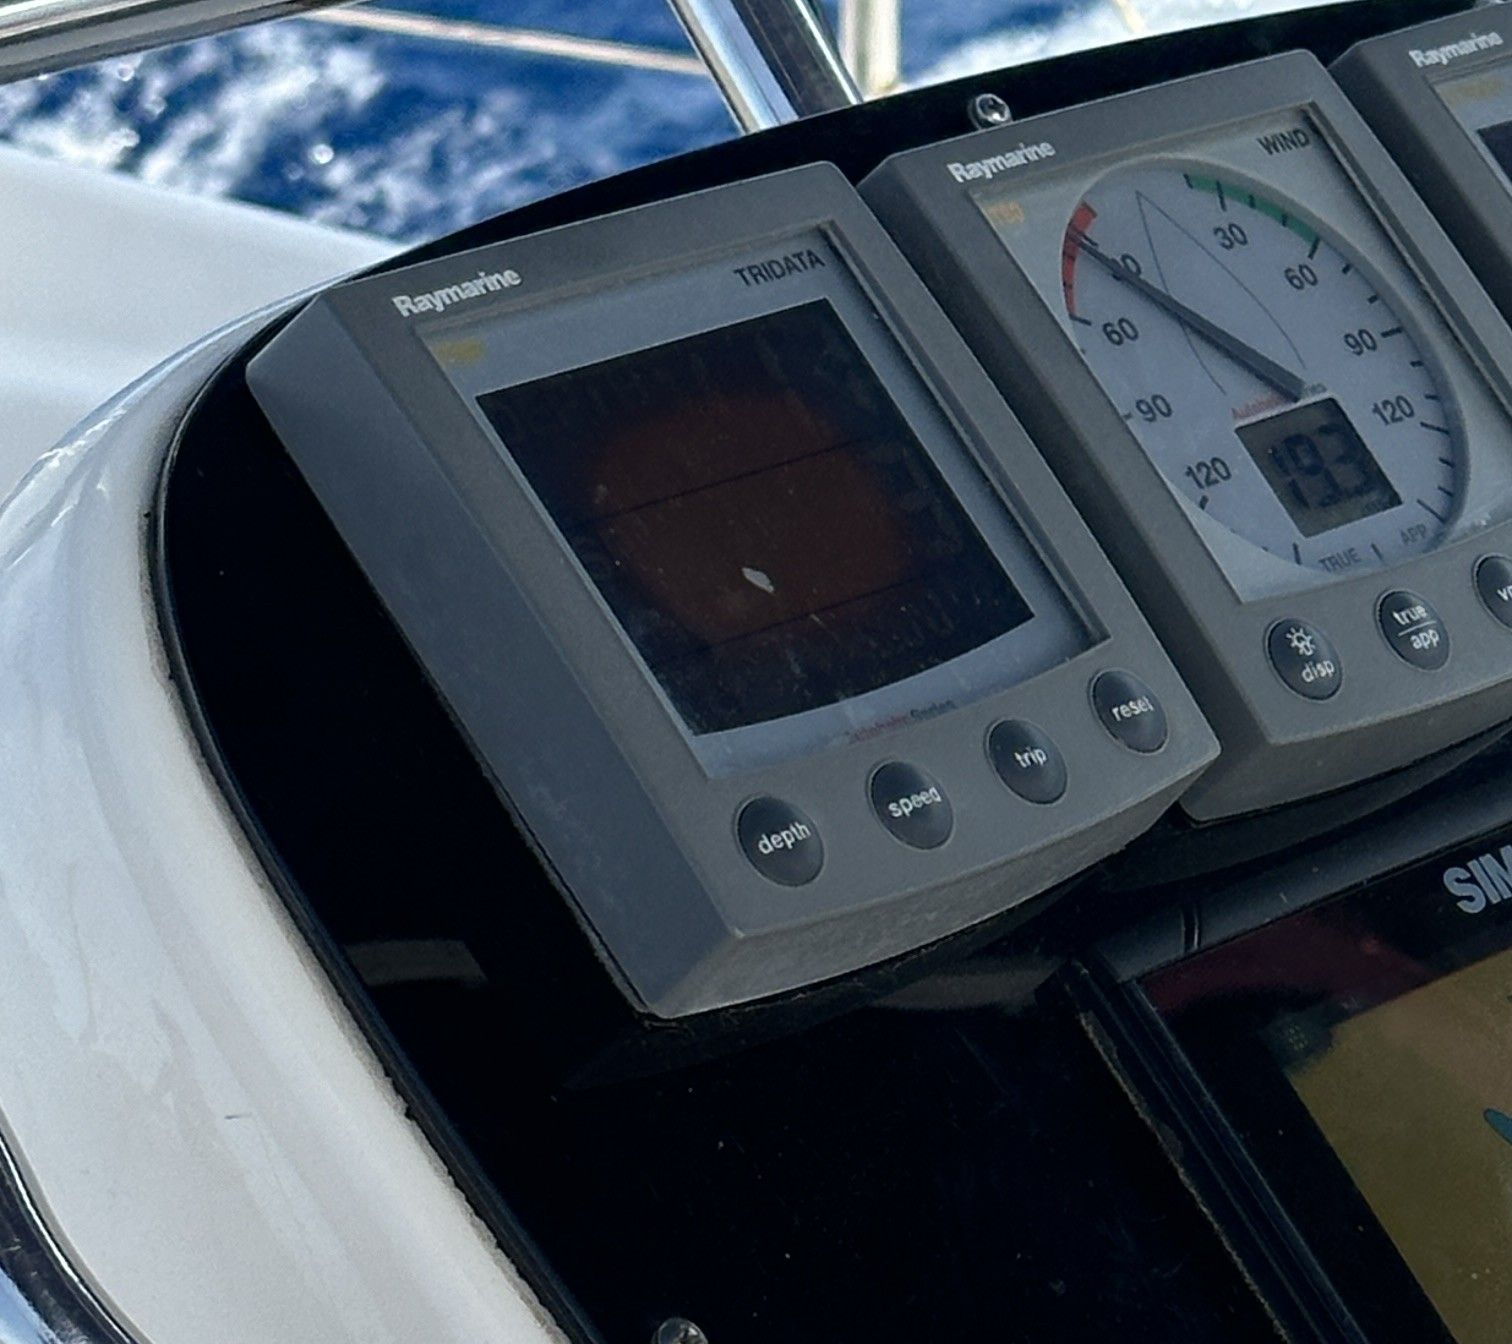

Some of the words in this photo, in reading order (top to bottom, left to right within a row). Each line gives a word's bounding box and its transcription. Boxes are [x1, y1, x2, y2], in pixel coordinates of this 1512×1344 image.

[1257, 128, 1310, 157] WIND
[946, 140, 1057, 184] Raymarine
[1213, 222, 1248, 252] 30
[733, 247, 827, 290] TRIDATA
[1284, 263, 1319, 292] 60
[391, 264, 522, 319] Raymarine
[1102, 317, 1139, 346] 60
[1343, 328, 1378, 357] 90
[1135, 393, 1175, 424] 90
[1371, 394, 1415, 427] 120
[1184, 456, 1233, 491] 120
[1318, 546, 1361, 575] TRUE
[1393, 603, 1429, 626] true
[1411, 628, 1440, 651] app
[1301, 659, 1336, 684] disp
[1111, 695, 1155, 723] reset
[1014, 744, 1048, 770] trip
[888, 786, 942, 820] speed
[757, 822, 812, 856] depth
